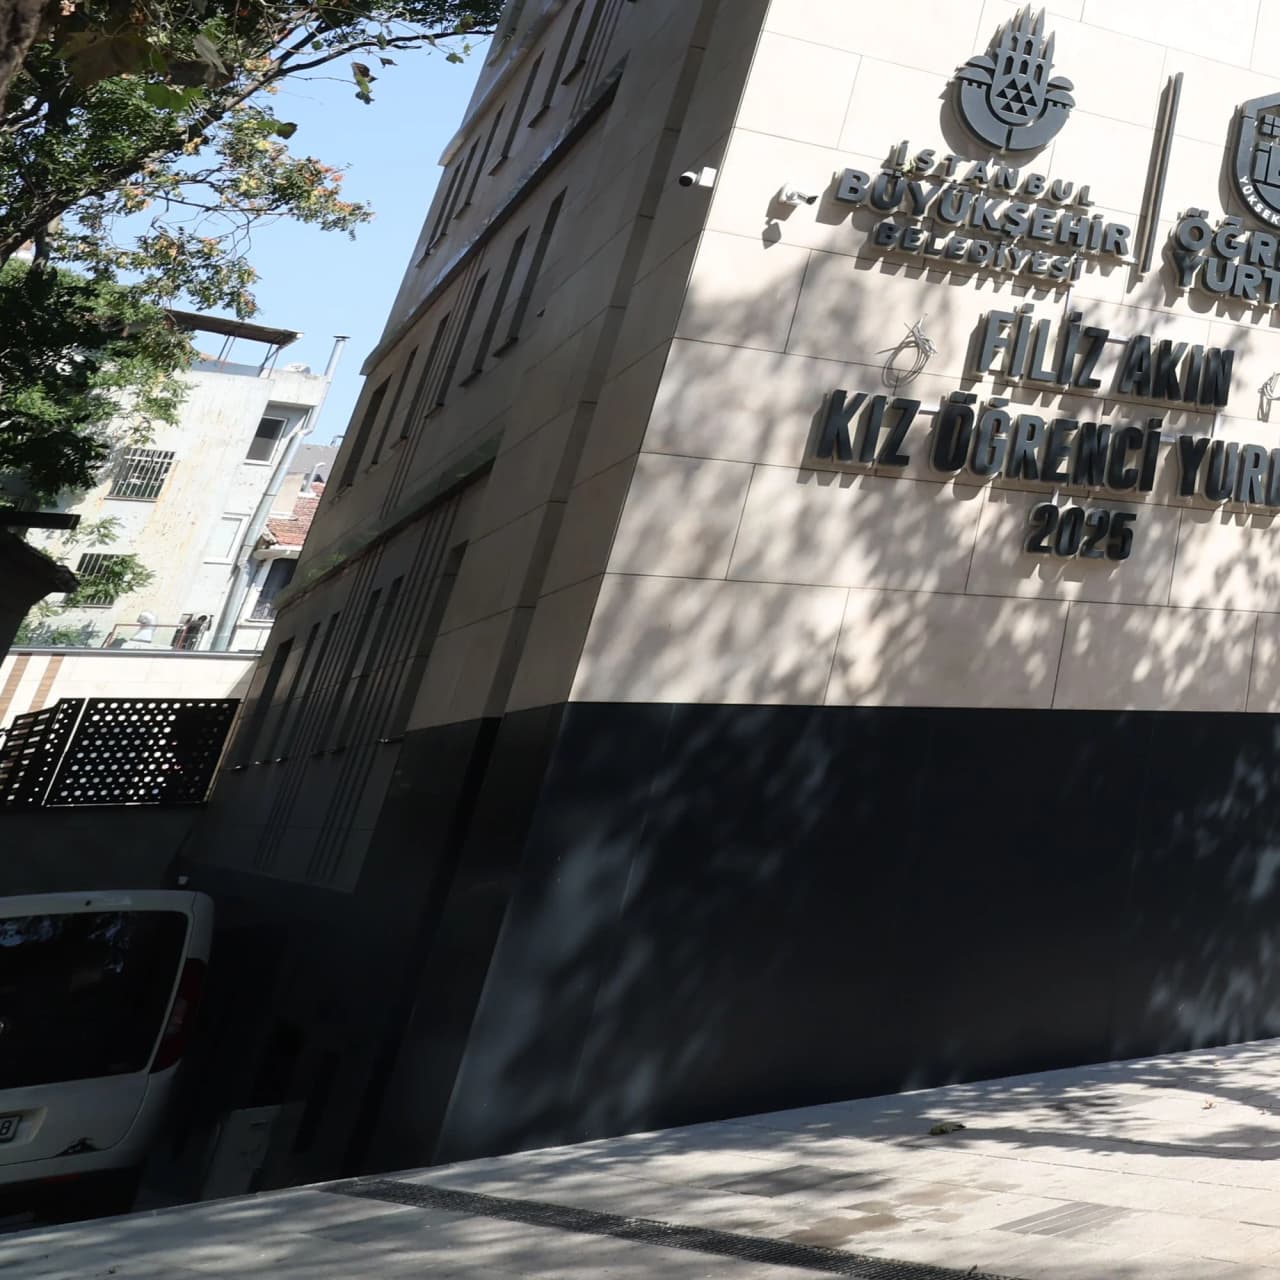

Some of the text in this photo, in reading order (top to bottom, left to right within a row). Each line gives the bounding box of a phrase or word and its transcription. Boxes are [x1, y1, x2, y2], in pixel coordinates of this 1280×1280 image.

[836, 167, 1132, 256] BÜYÜKŞEHİR
[894, 139, 1095, 207] İSTANBUL
[875, 221, 1084, 281] BELEDİYESİ
[976, 302, 1235, 408] FİLİZ AKIN
[815, 388, 922, 467] KIZ
[931, 390, 1163, 494] ÖĞRENCİ
[1024, 501, 1138, 561] 2025
